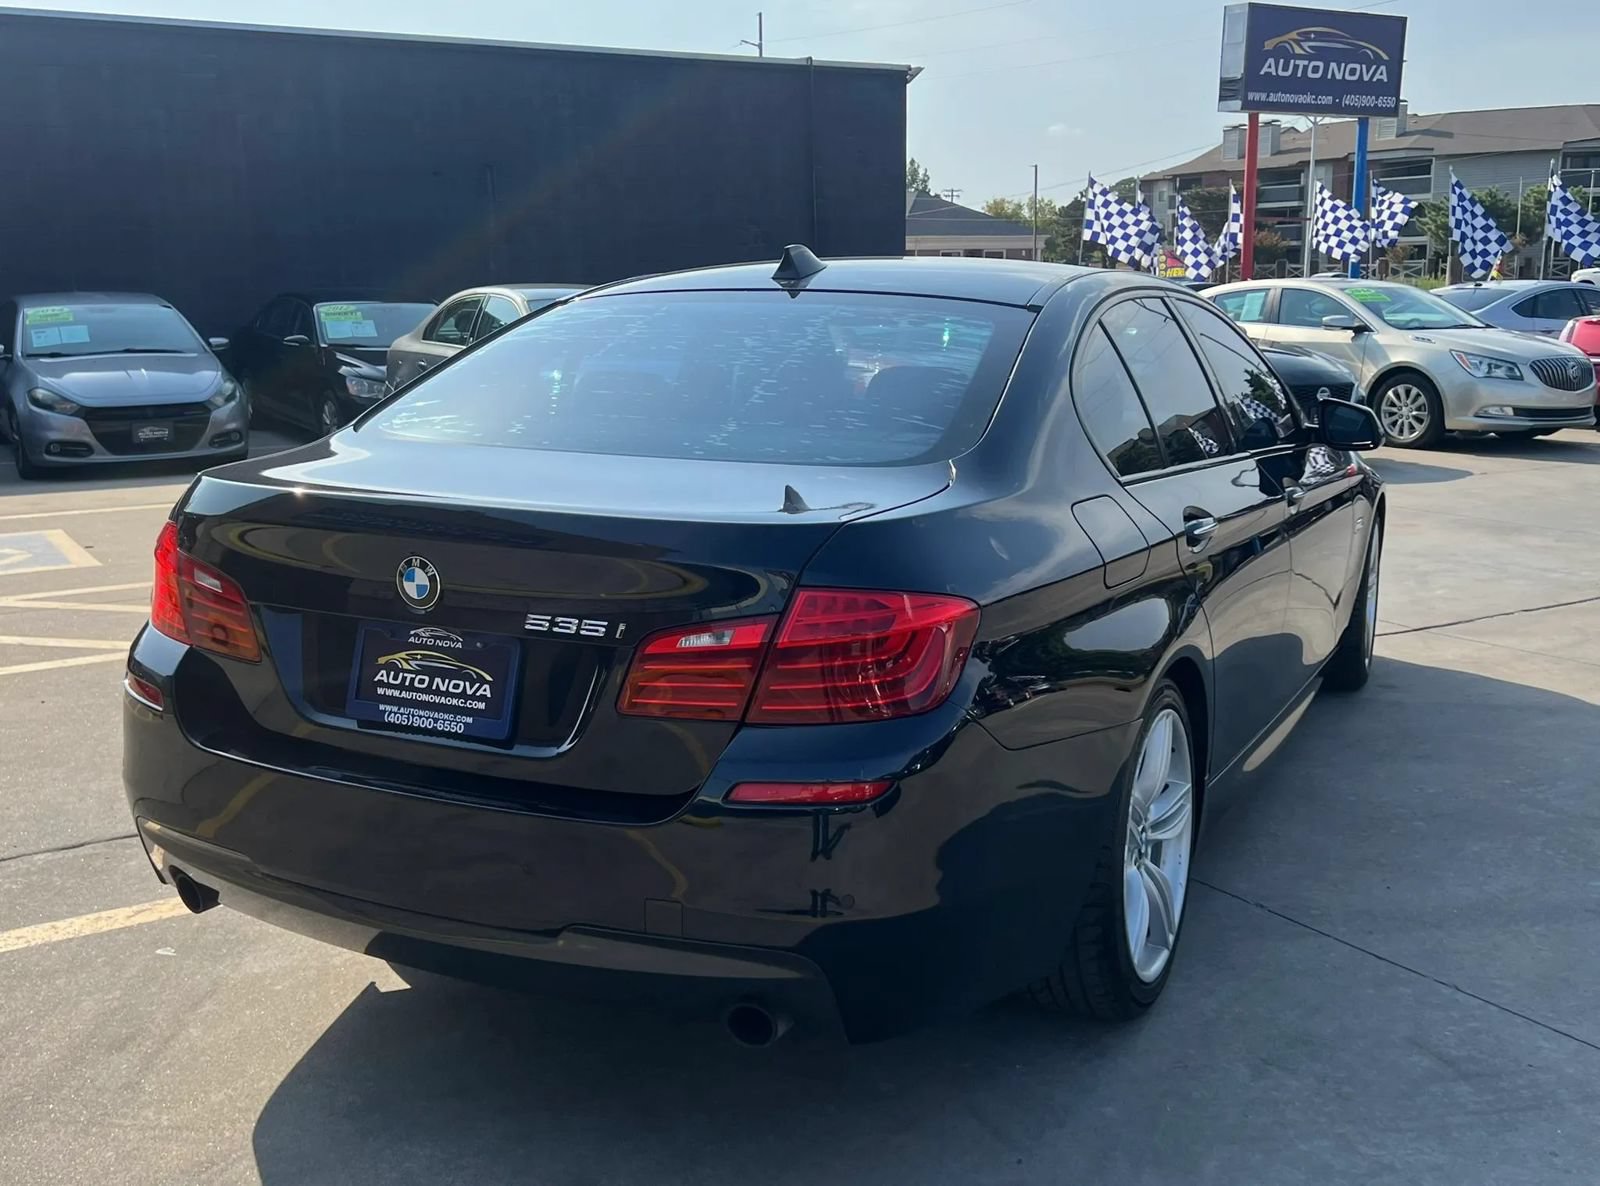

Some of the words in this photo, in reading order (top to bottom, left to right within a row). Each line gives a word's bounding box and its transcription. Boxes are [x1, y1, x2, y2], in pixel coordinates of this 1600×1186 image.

[1259, 57, 1324, 79] AUTO
[1327, 61, 1389, 83] NOVA
[1247, 91, 1333, 105] www.autonovaokc.com
[1341, 94, 1396, 108] (405)900-6550
[400, 557, 435, 577] BMW
[407, 635, 435, 646] AUTO
[435, 639, 463, 649] NOVA
[373, 669, 430, 689] AUTO
[431, 677, 492, 699] NOVA
[376, 686, 486, 710] WWW.AUTONOVAOKC.COM
[378, 703, 473, 724] WWW.AUTONOVAOKC.COM
[384, 711, 465, 734] (405)900-6550
